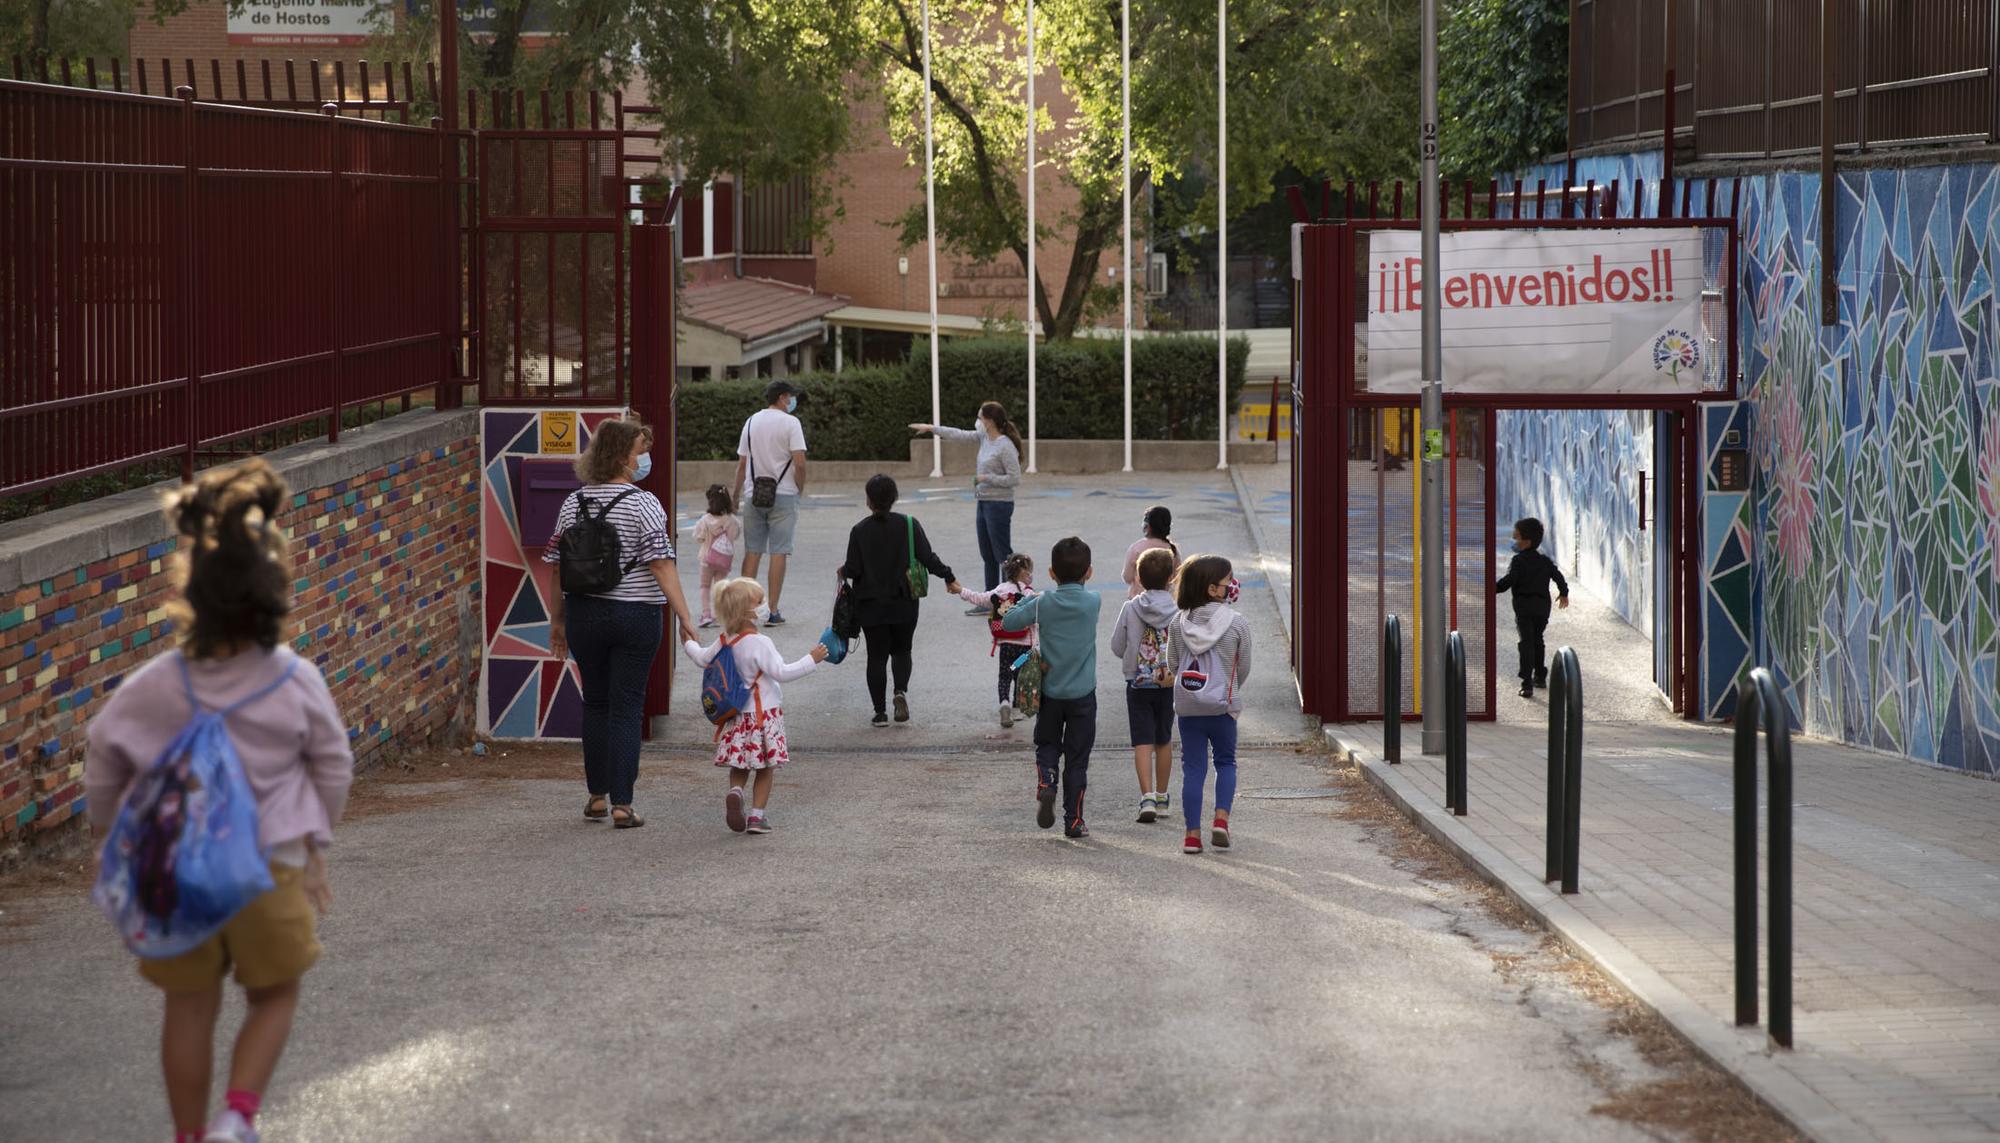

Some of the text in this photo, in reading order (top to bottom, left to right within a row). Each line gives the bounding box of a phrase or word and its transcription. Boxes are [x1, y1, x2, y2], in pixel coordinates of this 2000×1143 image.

[251, 11, 331, 24] de Hostos
[1378, 248, 1674, 313] ¡¡Benvenidos!!
[1653, 335, 1666, 370] Eugenio
[1680, 331, 1689, 339] de
[1688, 339, 1699, 369] Hostos
